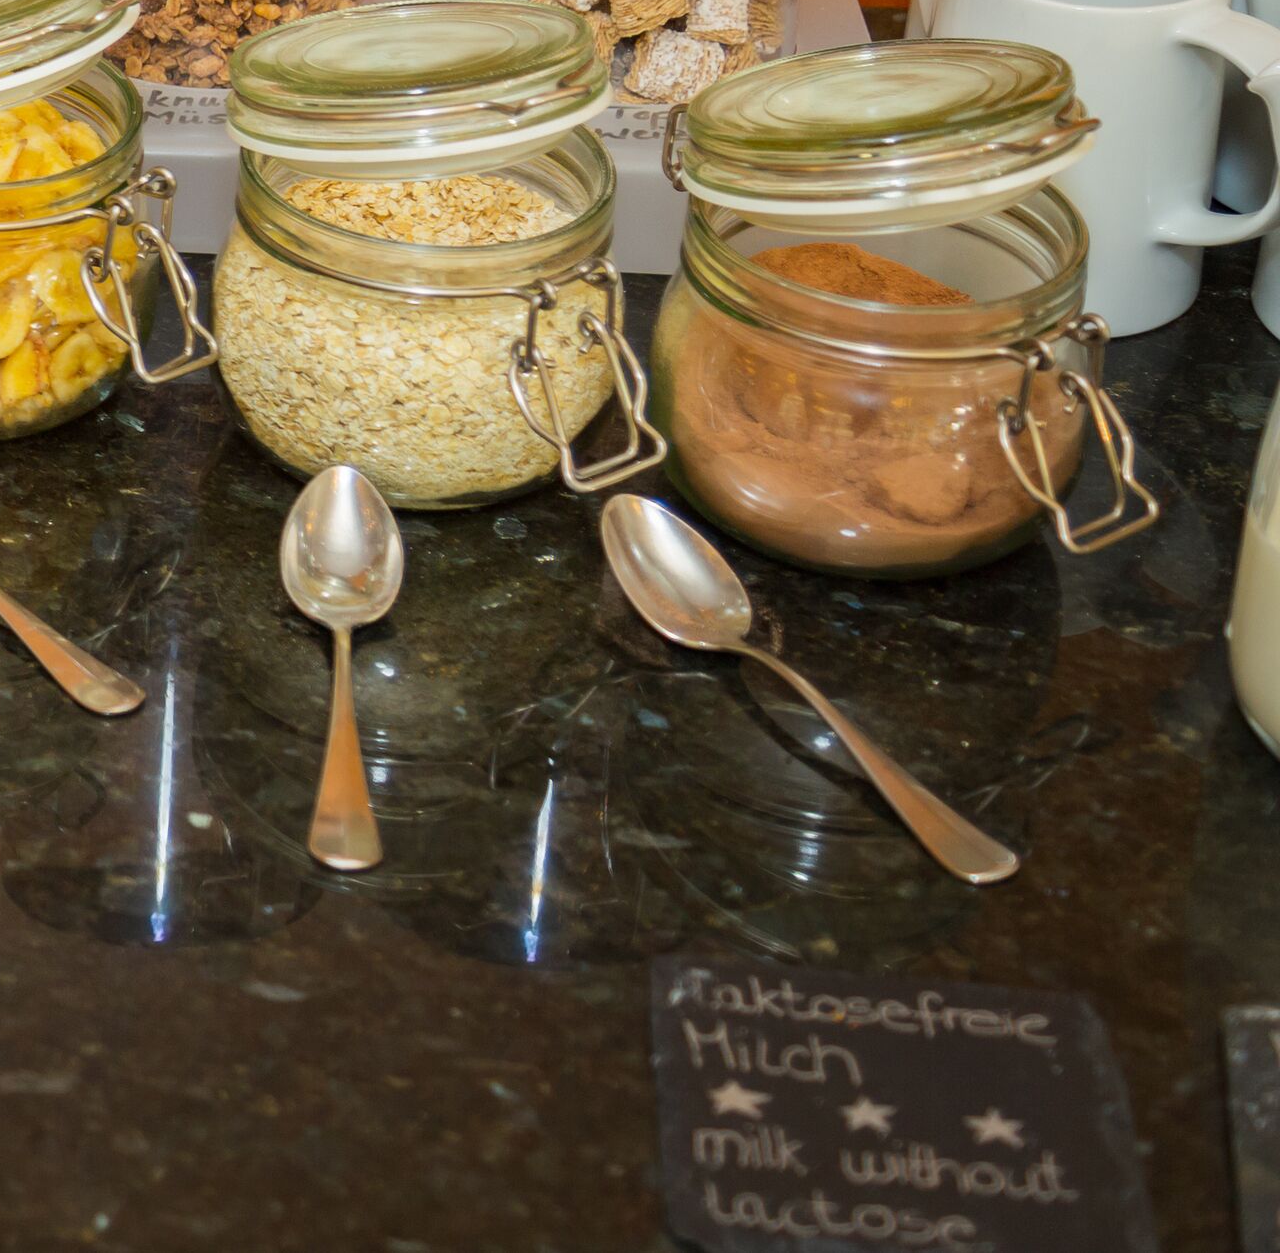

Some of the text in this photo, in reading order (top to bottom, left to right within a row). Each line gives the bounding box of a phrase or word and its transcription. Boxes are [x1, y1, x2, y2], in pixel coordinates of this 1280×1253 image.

[143, 109, 228, 125] Müs
[682, 1017, 864, 1087] Milch
[693, 1123, 1080, 1203] milk without
